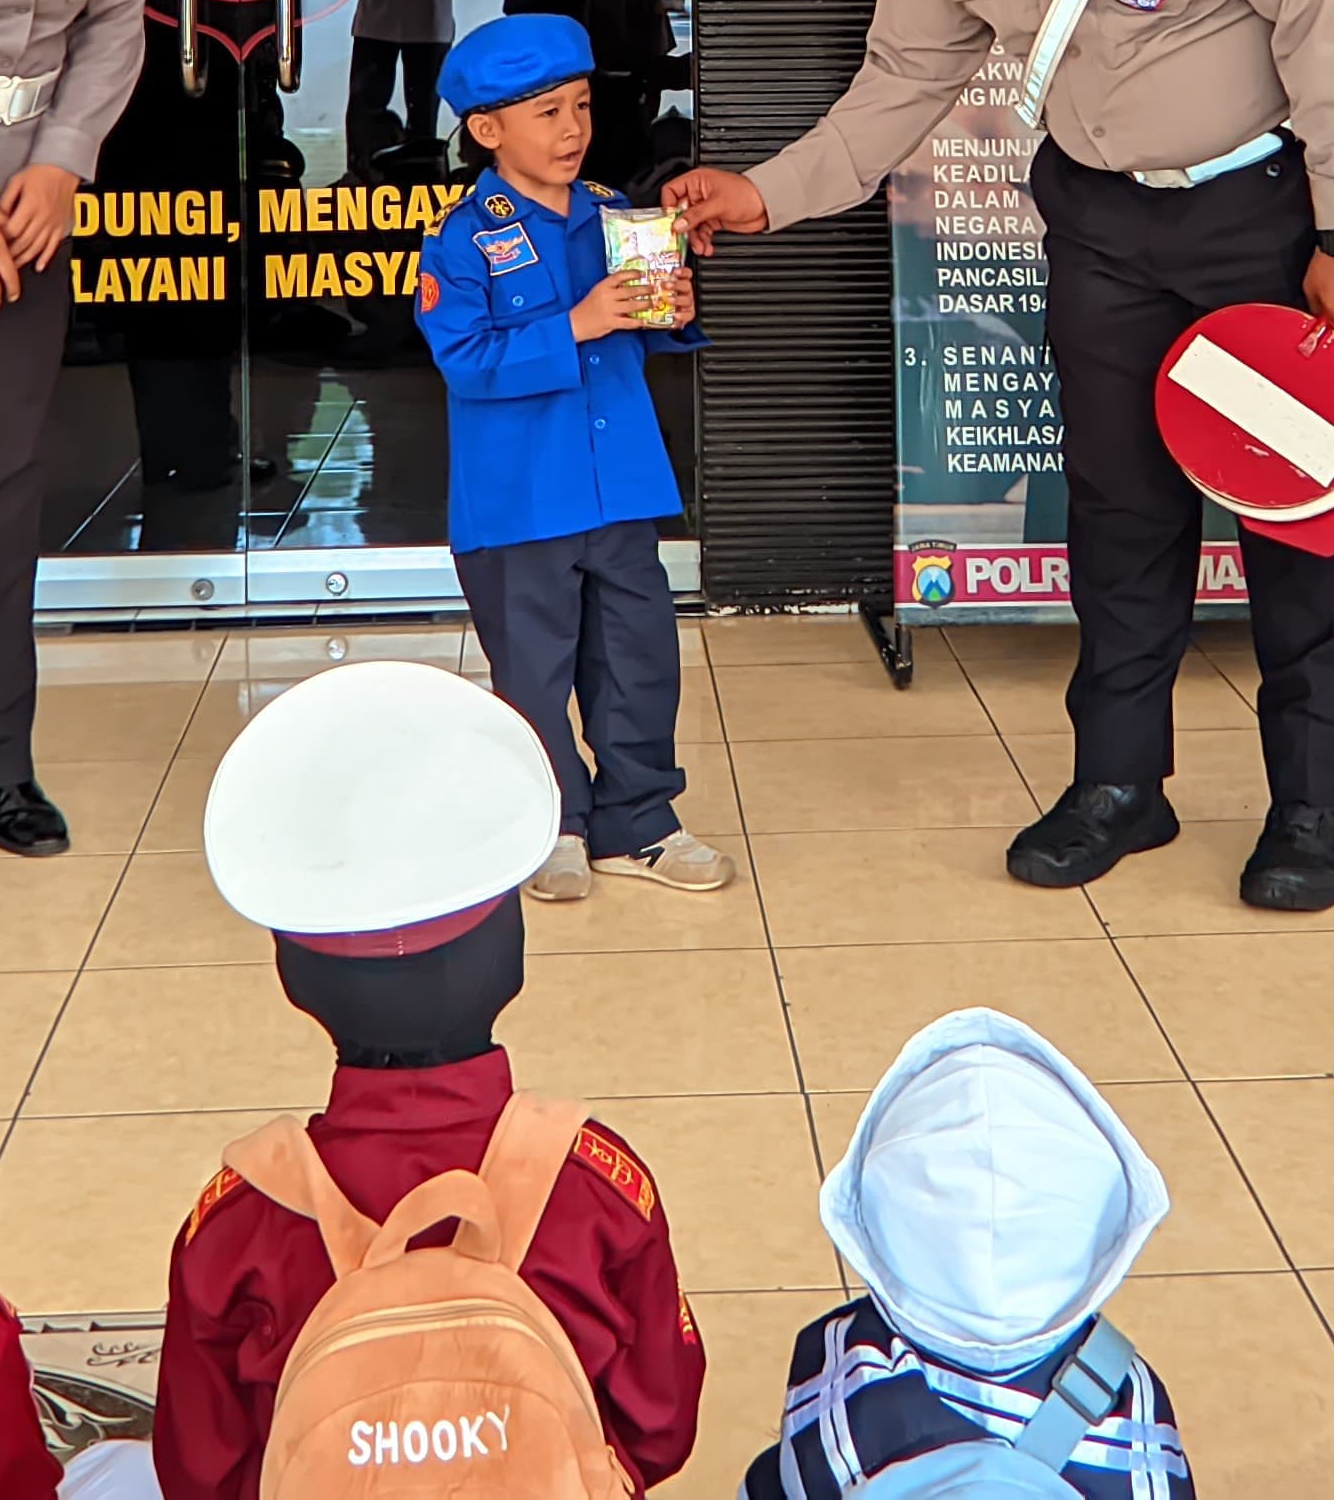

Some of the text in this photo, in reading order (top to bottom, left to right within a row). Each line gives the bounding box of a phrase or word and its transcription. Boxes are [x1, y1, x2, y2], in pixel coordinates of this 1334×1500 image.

[935, 189, 1020, 209] DALAM
[71, 184, 475, 243] DUNGI, MENGAY
[935, 215, 1037, 235] NEGARA
[936, 241, 1047, 261] INDONESI
[73, 256, 226, 303] LAYANI
[938, 267, 1048, 287] PANCASIL
[938, 294, 1015, 313] DASAR
[904, 347, 927, 367] 3.
[944, 372, 1054, 393] MENGAY
[945, 399, 1055, 419] MASYA
[348, 1404, 510, 1465] SHOOKY
